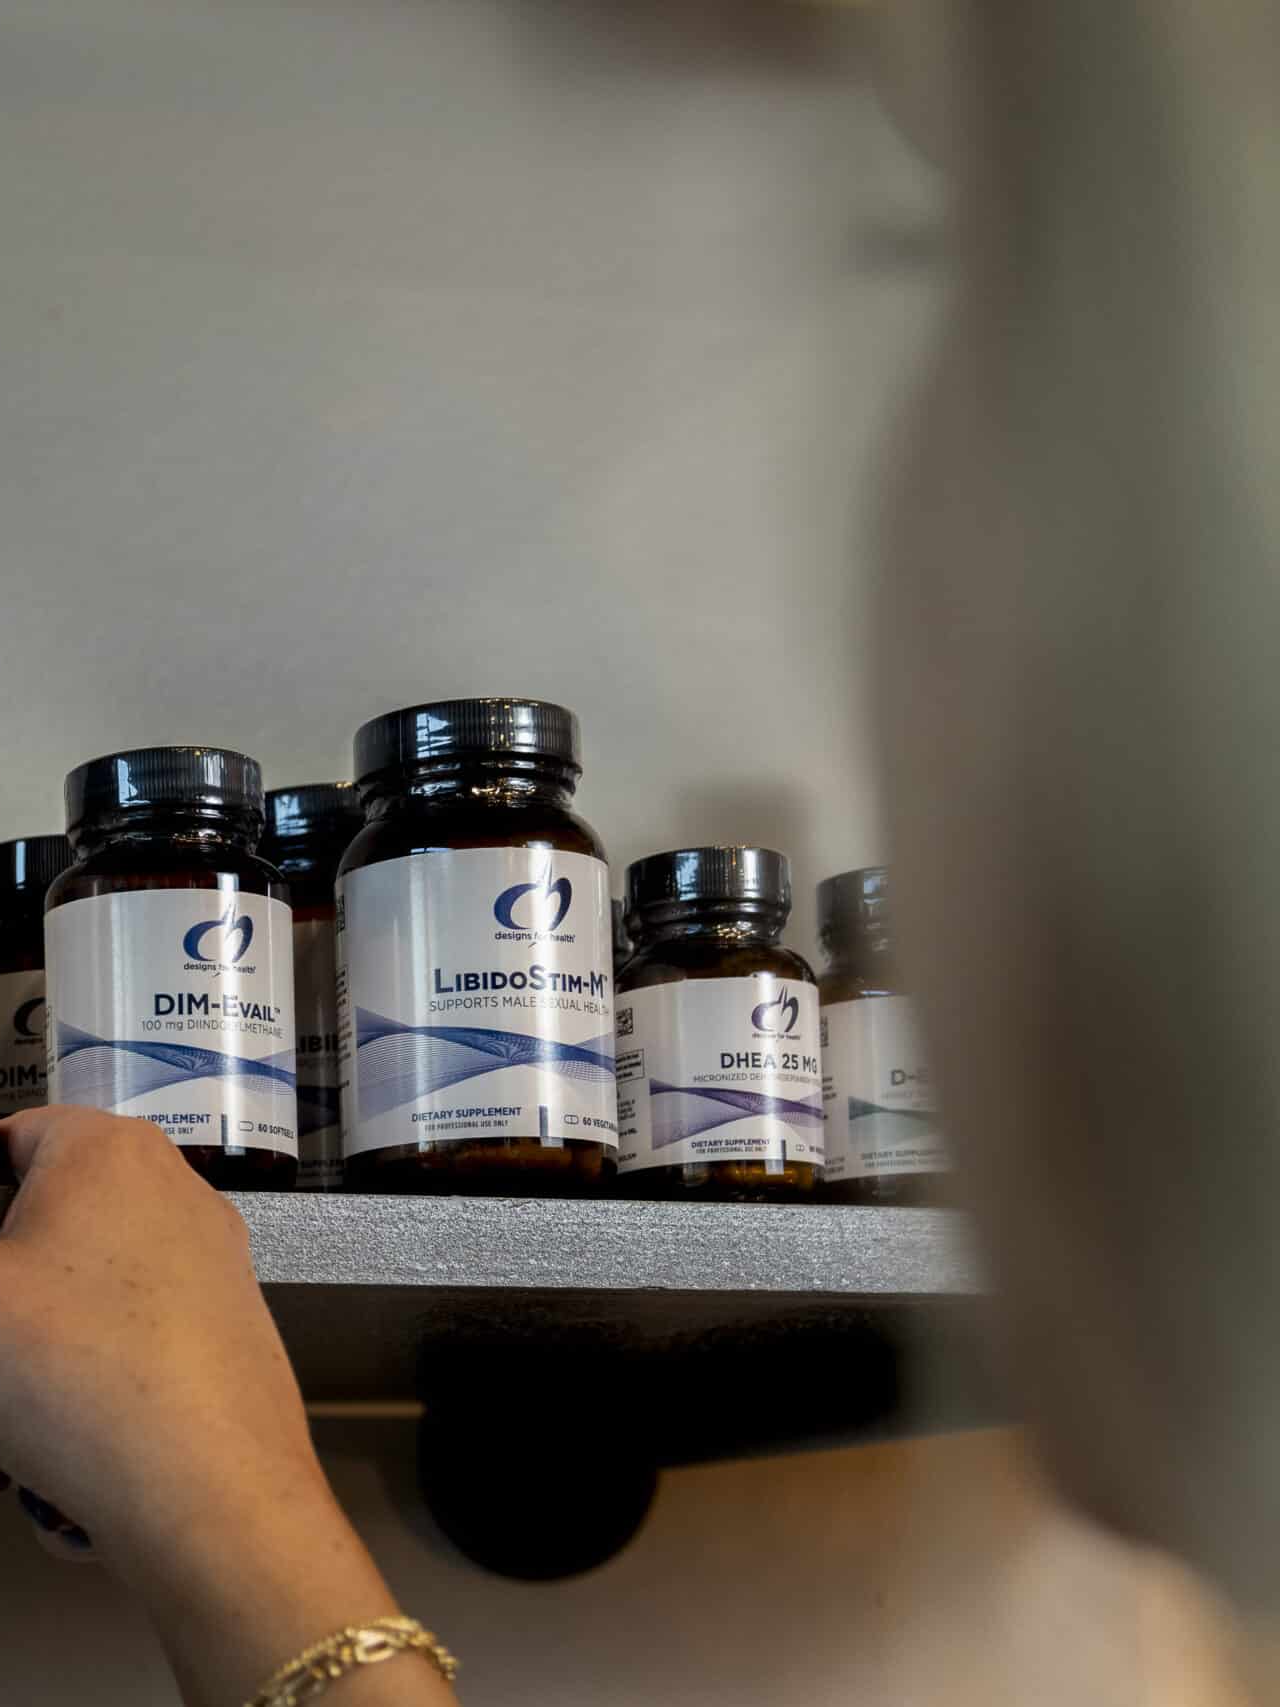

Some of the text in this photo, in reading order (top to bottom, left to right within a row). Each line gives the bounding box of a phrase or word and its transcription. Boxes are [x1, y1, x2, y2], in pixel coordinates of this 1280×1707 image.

[494, 931, 532, 941] designs
[183, 962, 216, 972] designs
[429, 996, 499, 1012] SUPPORTS
[502, 996, 537, 1008] MALE
[142, 1020, 162, 1031] 100
[165, 1021, 184, 1031] mg
[720, 1052, 817, 1075] DHEA 25 MG
[411, 1106, 522, 1123] DIETARY SUPPLEMENT
[582, 1117, 592, 1126] 60
